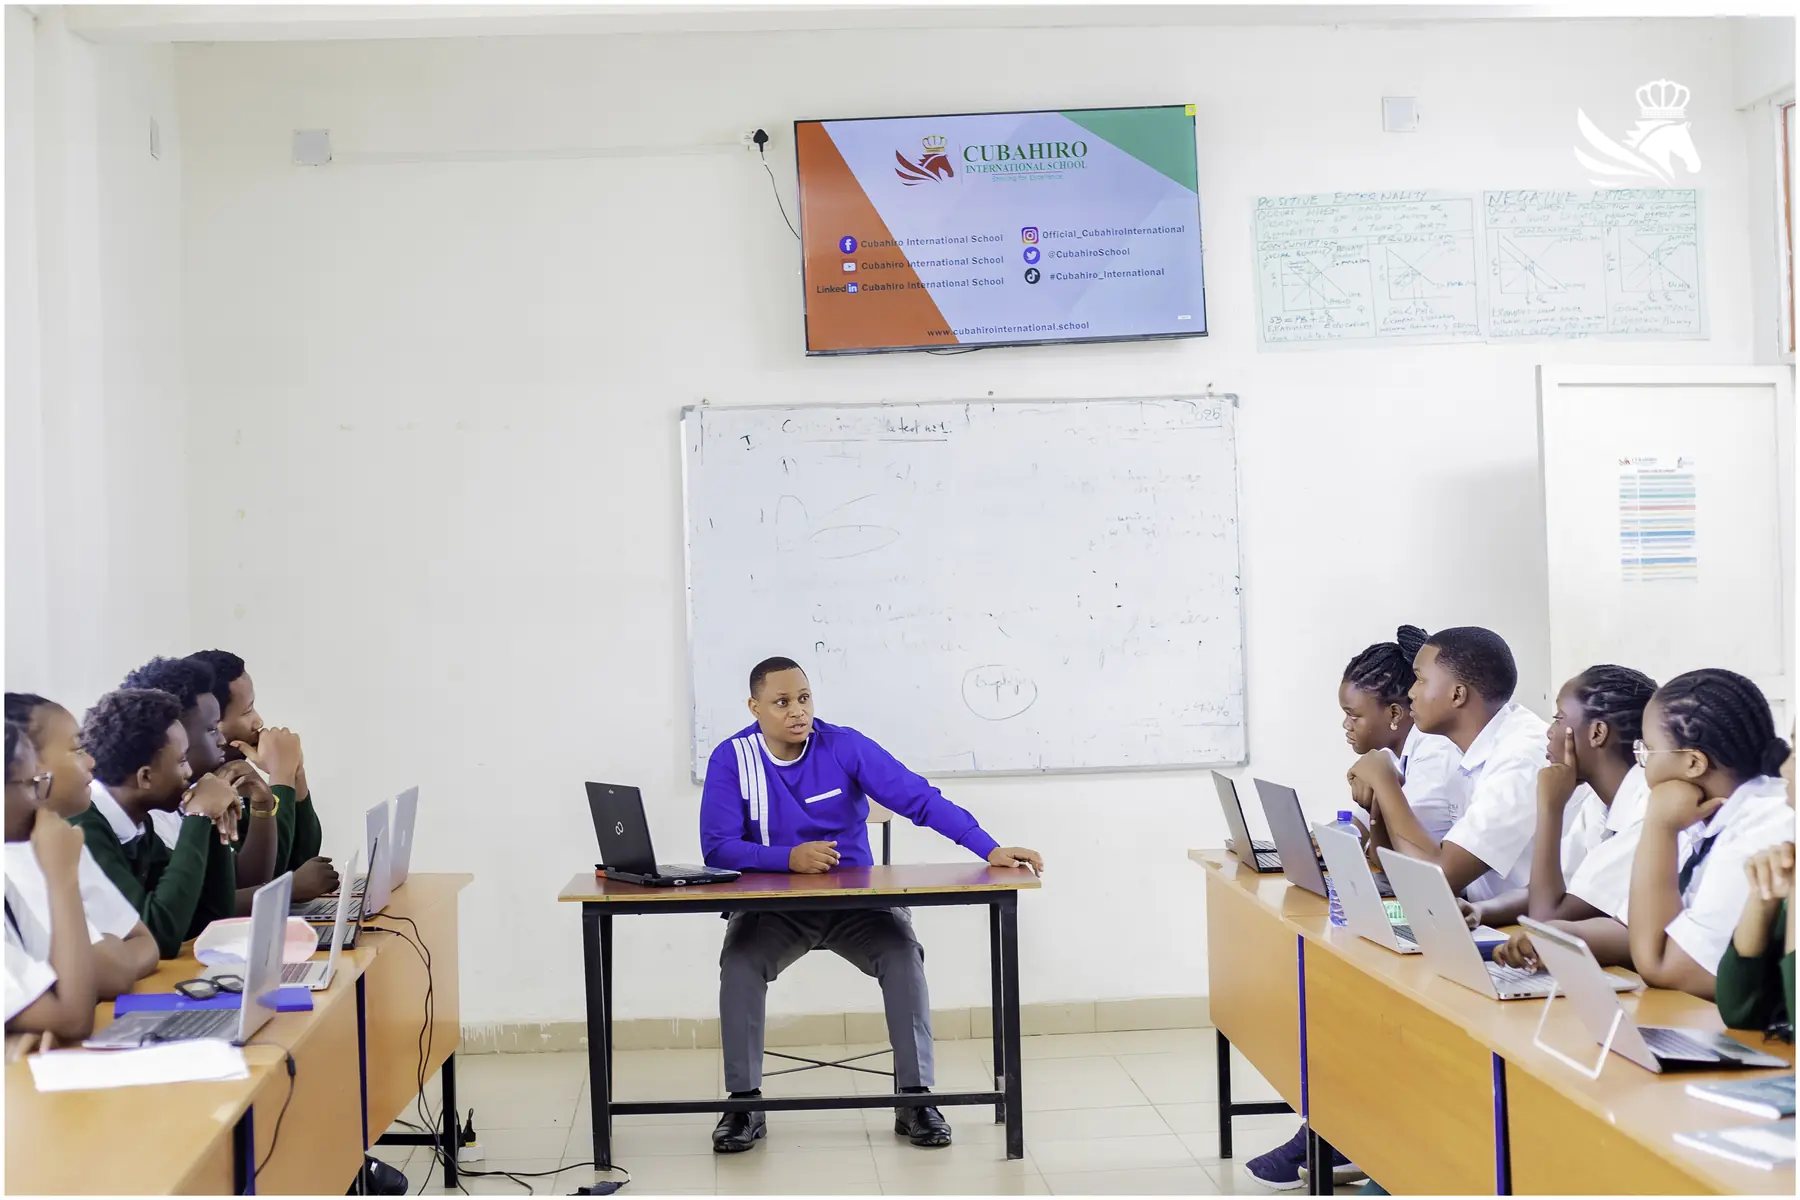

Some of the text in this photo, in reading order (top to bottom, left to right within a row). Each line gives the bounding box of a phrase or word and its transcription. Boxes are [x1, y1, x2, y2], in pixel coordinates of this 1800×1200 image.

[963, 140, 1088, 163] CUBAHIRO
[966, 160, 1088, 174] INTERNATIONAL SCHOOL
[1257, 195, 1318, 208] POSITIVE
[1042, 225, 1185, 240] Official_CubahiroInternational
[861, 233, 1004, 249] Cubahiro International School
[1047, 247, 1131, 259] @CubahiroSchool
[861, 255, 1004, 270] Cubahiro International School
[1049, 268, 1165, 281] #Cubahiro_International
[861, 282, 905, 292] Cubahiro
[907, 278, 969, 290] International
[971, 276, 1004, 287] School
[927, 321, 1090, 337] www.cubahirointernational.school
